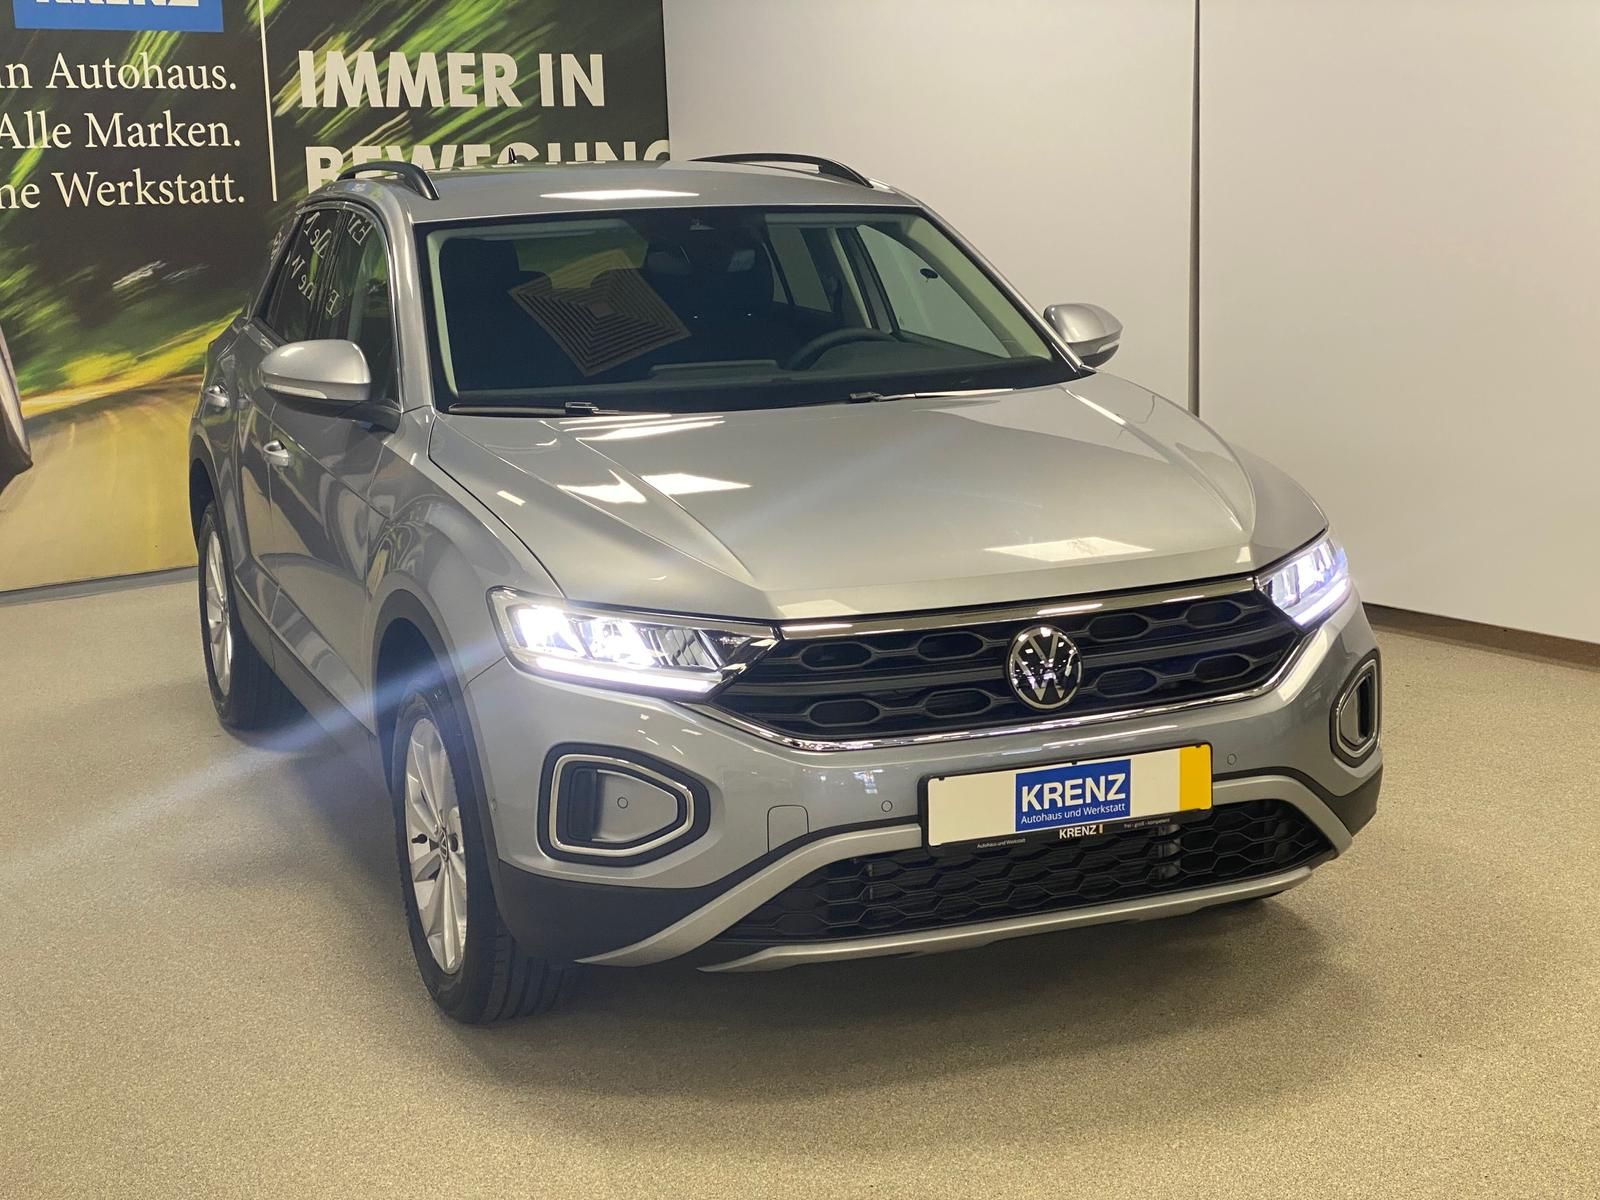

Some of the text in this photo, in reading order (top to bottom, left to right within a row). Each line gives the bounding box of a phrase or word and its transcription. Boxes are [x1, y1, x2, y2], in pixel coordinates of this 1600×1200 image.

[0, 52, 237, 90] n Autohaus.
[298, 50, 605, 108] IMMER IN
[0, 109, 241, 149] Alle Marken.
[51, 168, 245, 208] Werkstatt.
[1022, 773, 1126, 812] KRENZ
[1021, 803, 1126, 825] Autohaus und Werkstatt
[1059, 825, 1097, 839] KRENZ
